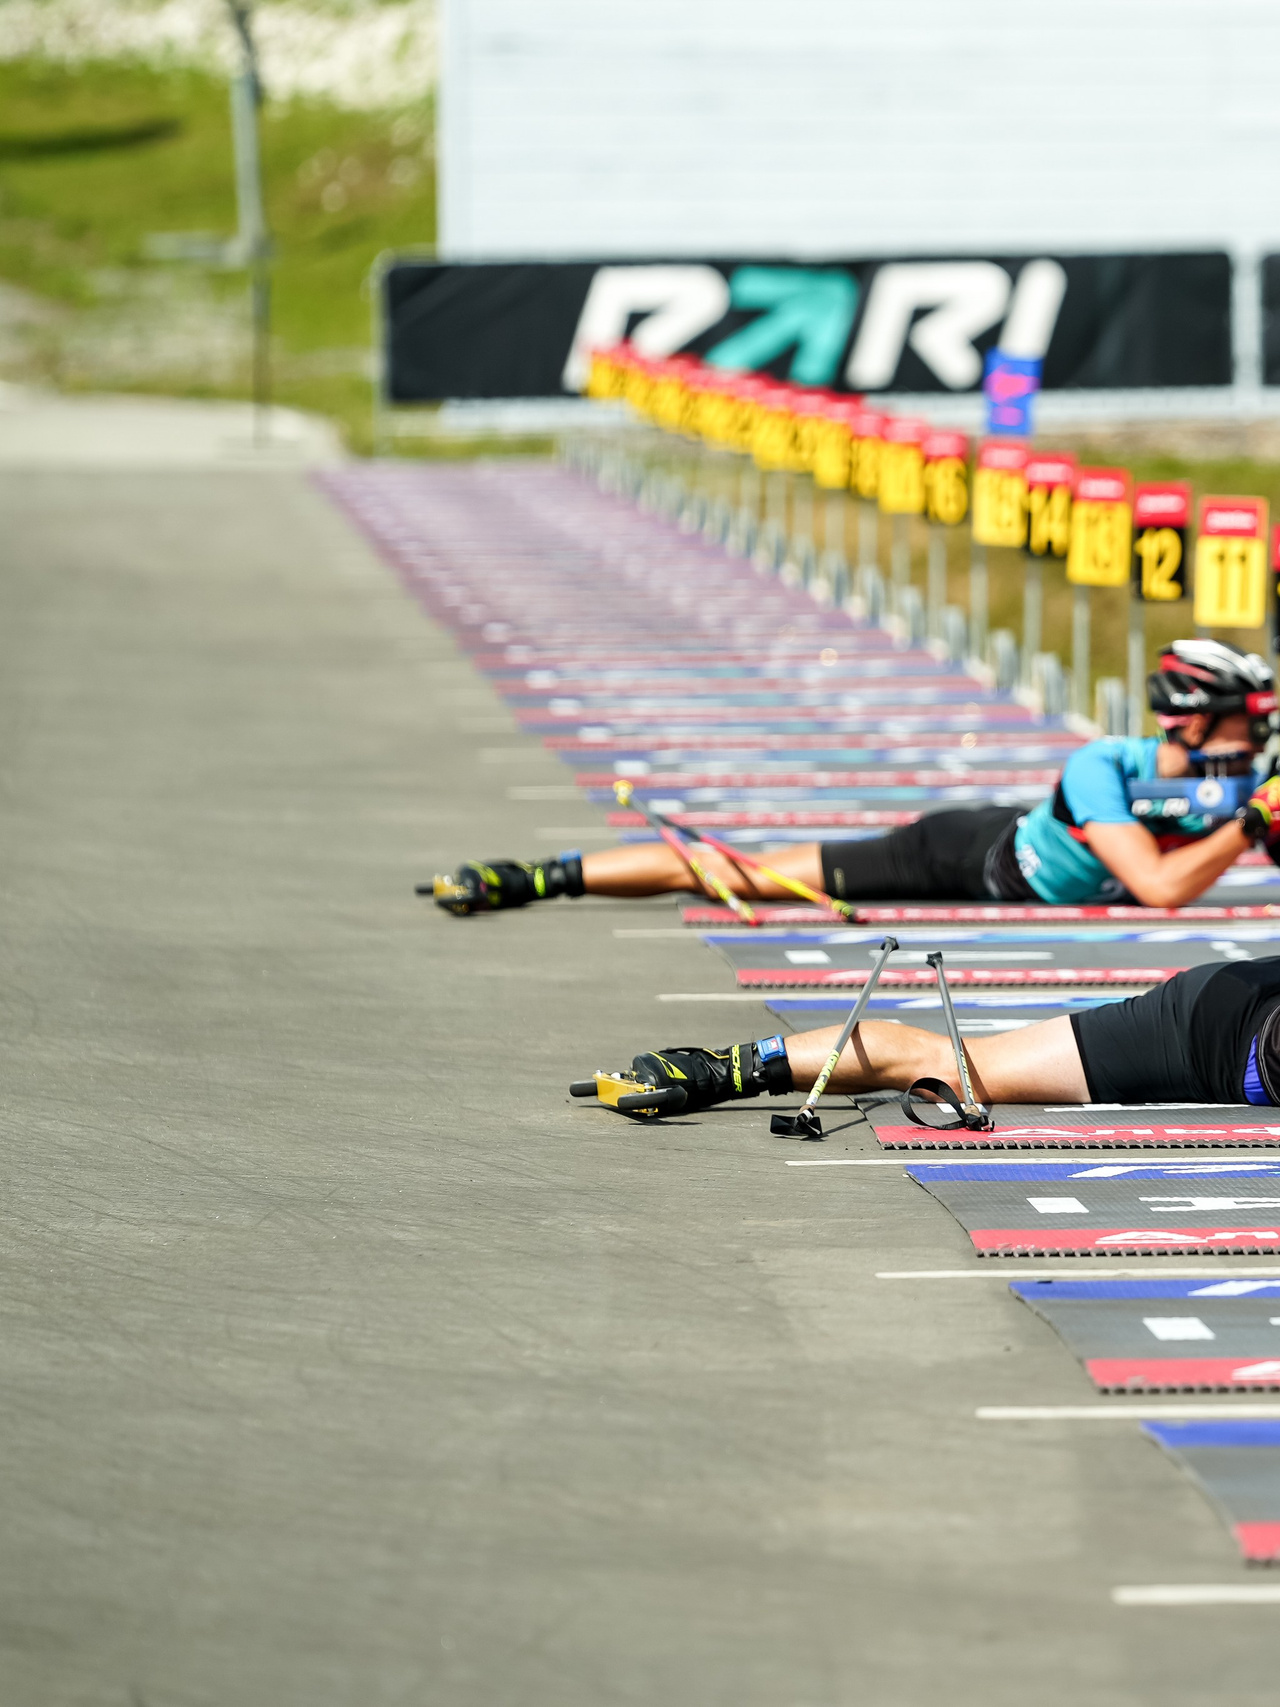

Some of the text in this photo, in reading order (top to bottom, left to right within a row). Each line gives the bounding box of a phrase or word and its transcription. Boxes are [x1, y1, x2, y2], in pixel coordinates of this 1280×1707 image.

[563, 258, 1067, 392] PARI
[1134, 527, 1182, 600] 12
[1214, 548, 1253, 615] 11
